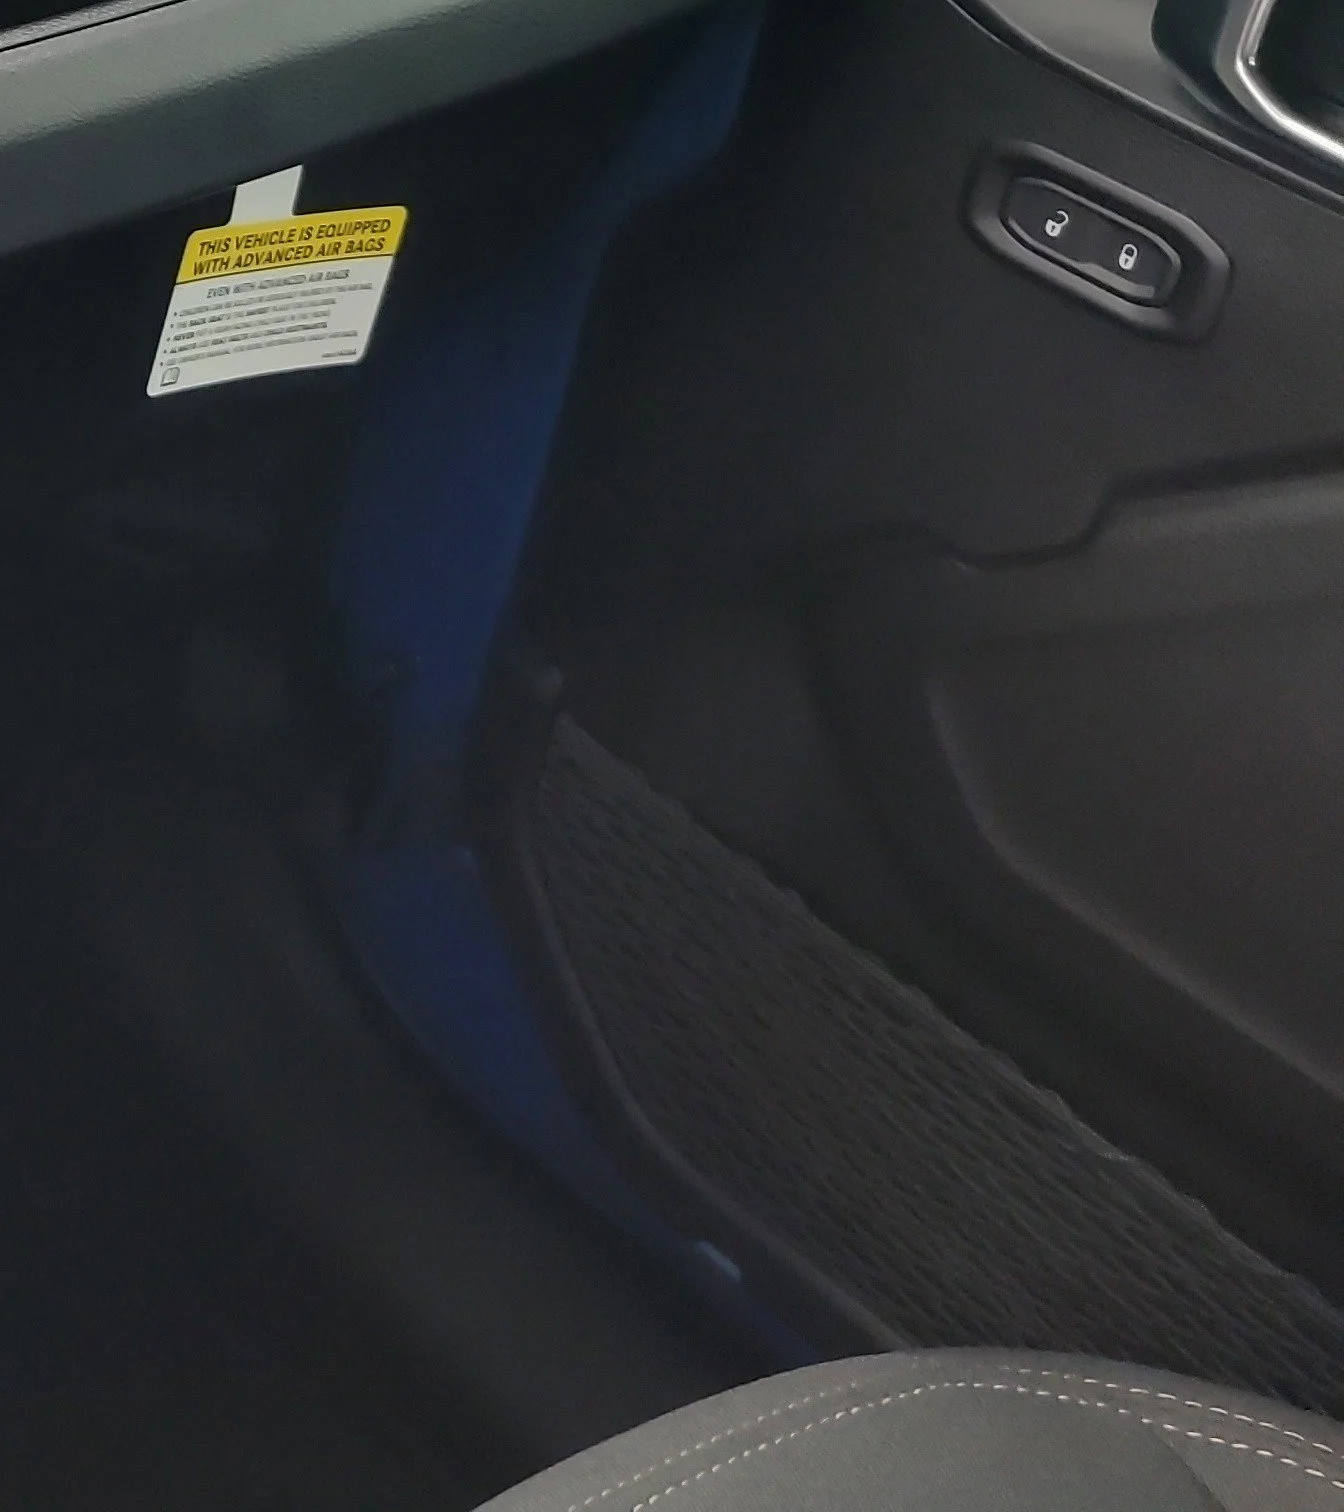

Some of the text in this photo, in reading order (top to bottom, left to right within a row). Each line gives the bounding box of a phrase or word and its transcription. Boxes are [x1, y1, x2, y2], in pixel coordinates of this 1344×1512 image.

[193, 237, 386, 276] WITH ADVANCED AIR BAGS
[199, 219, 392, 256] THIS VEHICLE IS EQUIPPED
